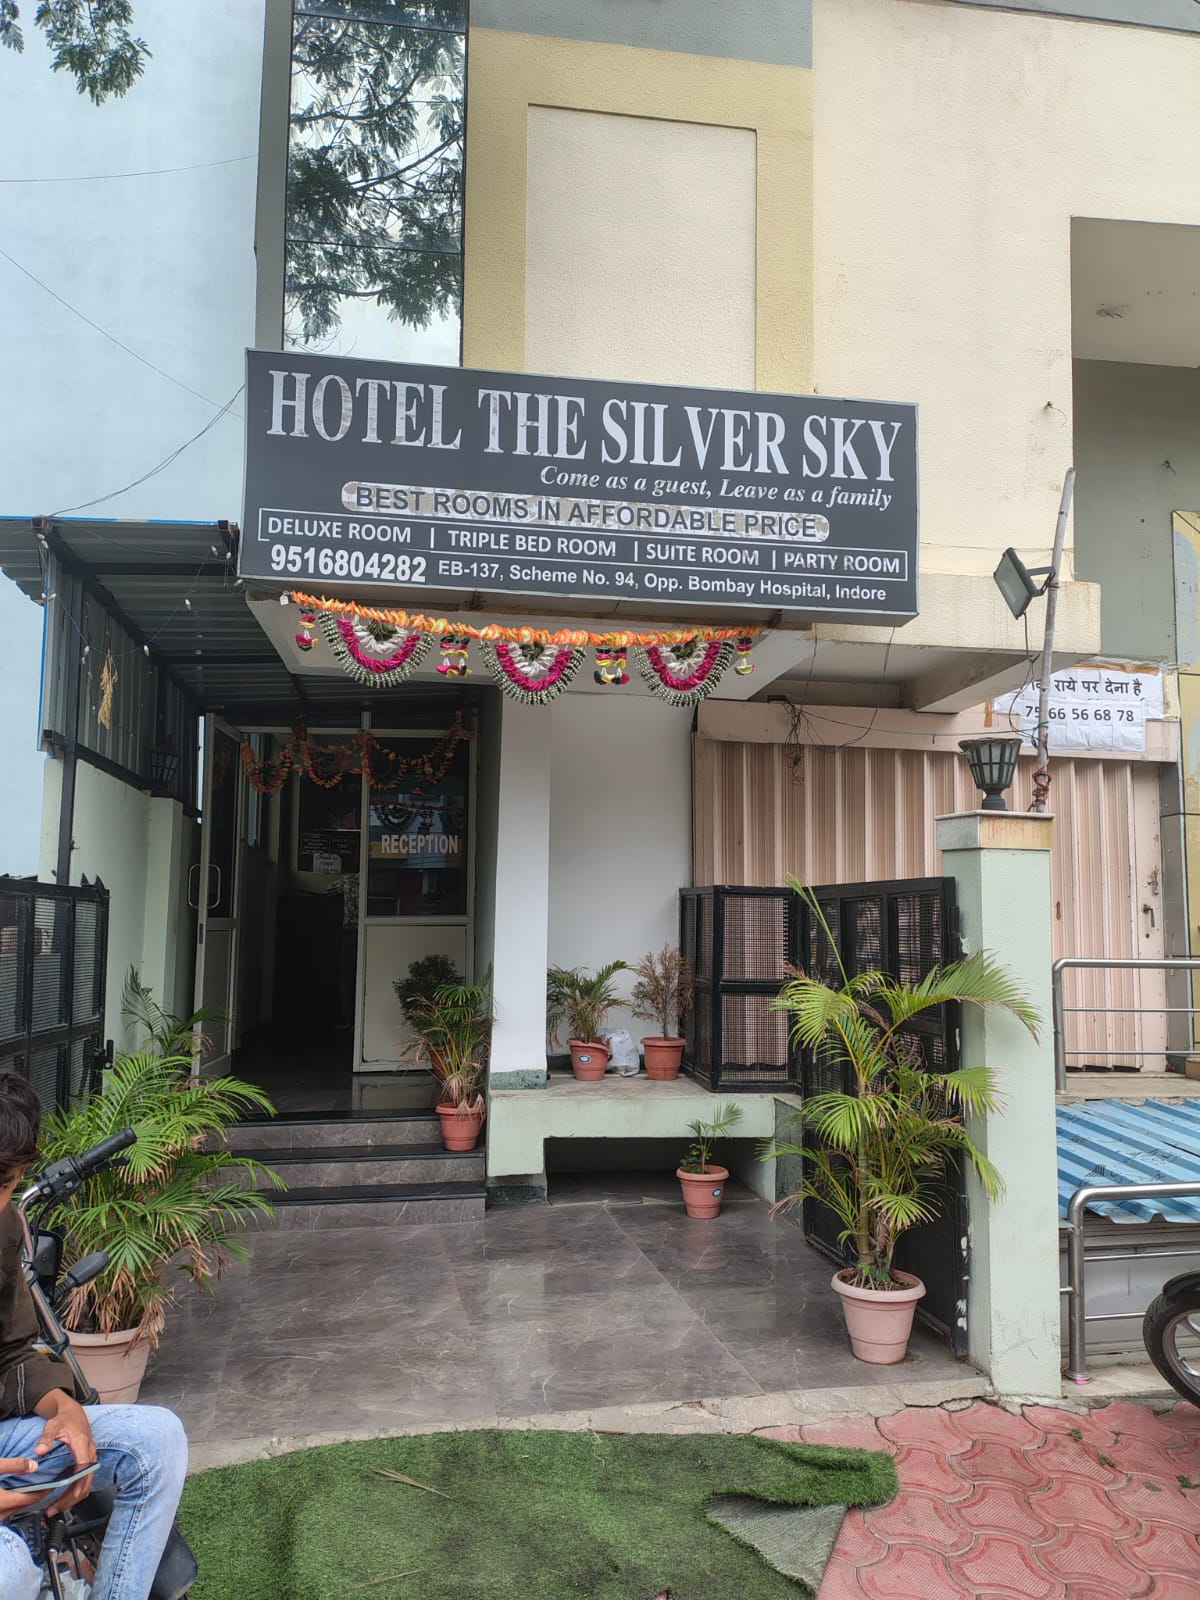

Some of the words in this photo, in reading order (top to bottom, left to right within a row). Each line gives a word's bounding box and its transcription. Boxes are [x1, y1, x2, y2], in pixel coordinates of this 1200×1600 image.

[266, 370, 462, 450] HOTEL
[477, 388, 587, 460] THE
[601, 398, 790, 475] SILVER
[802, 414, 903, 482] SKY
[540, 465, 600, 488] Come
[605, 476, 628, 490] as
[633, 478, 647, 491] a
[651, 480, 712, 500] guest,
[719, 478, 779, 500] Leave
[783, 488, 805, 502] as
[811, 491, 824, 503] a
[825, 485, 892, 512] family
[356, 486, 425, 511] BEST
[434, 493, 529, 519] ROOMS
[537, 500, 561, 521] IN
[567, 503, 736, 533] AFFORDABLE
[744, 514, 817, 538] PRICE
[268, 516, 342, 539] DELUXE
[348, 522, 411, 543] ROOM
[447, 529, 510, 550] TRIPLE
[515, 534, 552, 553] BED
[557, 537, 617, 557] ROOM
[646, 543, 697, 562] SUITE
[701, 546, 760, 566] ROOM
[784, 552, 838, 570] PARTY
[843, 555, 900, 574] ROOM
[270, 543, 428, 583] 9516804282
[438, 559, 504, 582] EB-137,
[509, 564, 578, 583] Scheme
[582, 569, 610, 587] No.
[615, 571, 639, 589] 94,
[644, 572, 683, 592] Opp.
[688, 575, 756, 597] Bombay
[760, 579, 831, 601] Hospital,
[835, 584, 887, 602] Indore
[1081, 680, 1100, 694] पर
[1104, 677, 1130, 695] देना
[1132, 678, 1143, 697] है
[1048, 707, 1066, 720] 66
[1071, 708, 1089, 721] 56
[1093, 709, 1112, 721] 68
[1116, 709, 1135, 722] 78
[381, 834, 459, 854] RECEPTION
